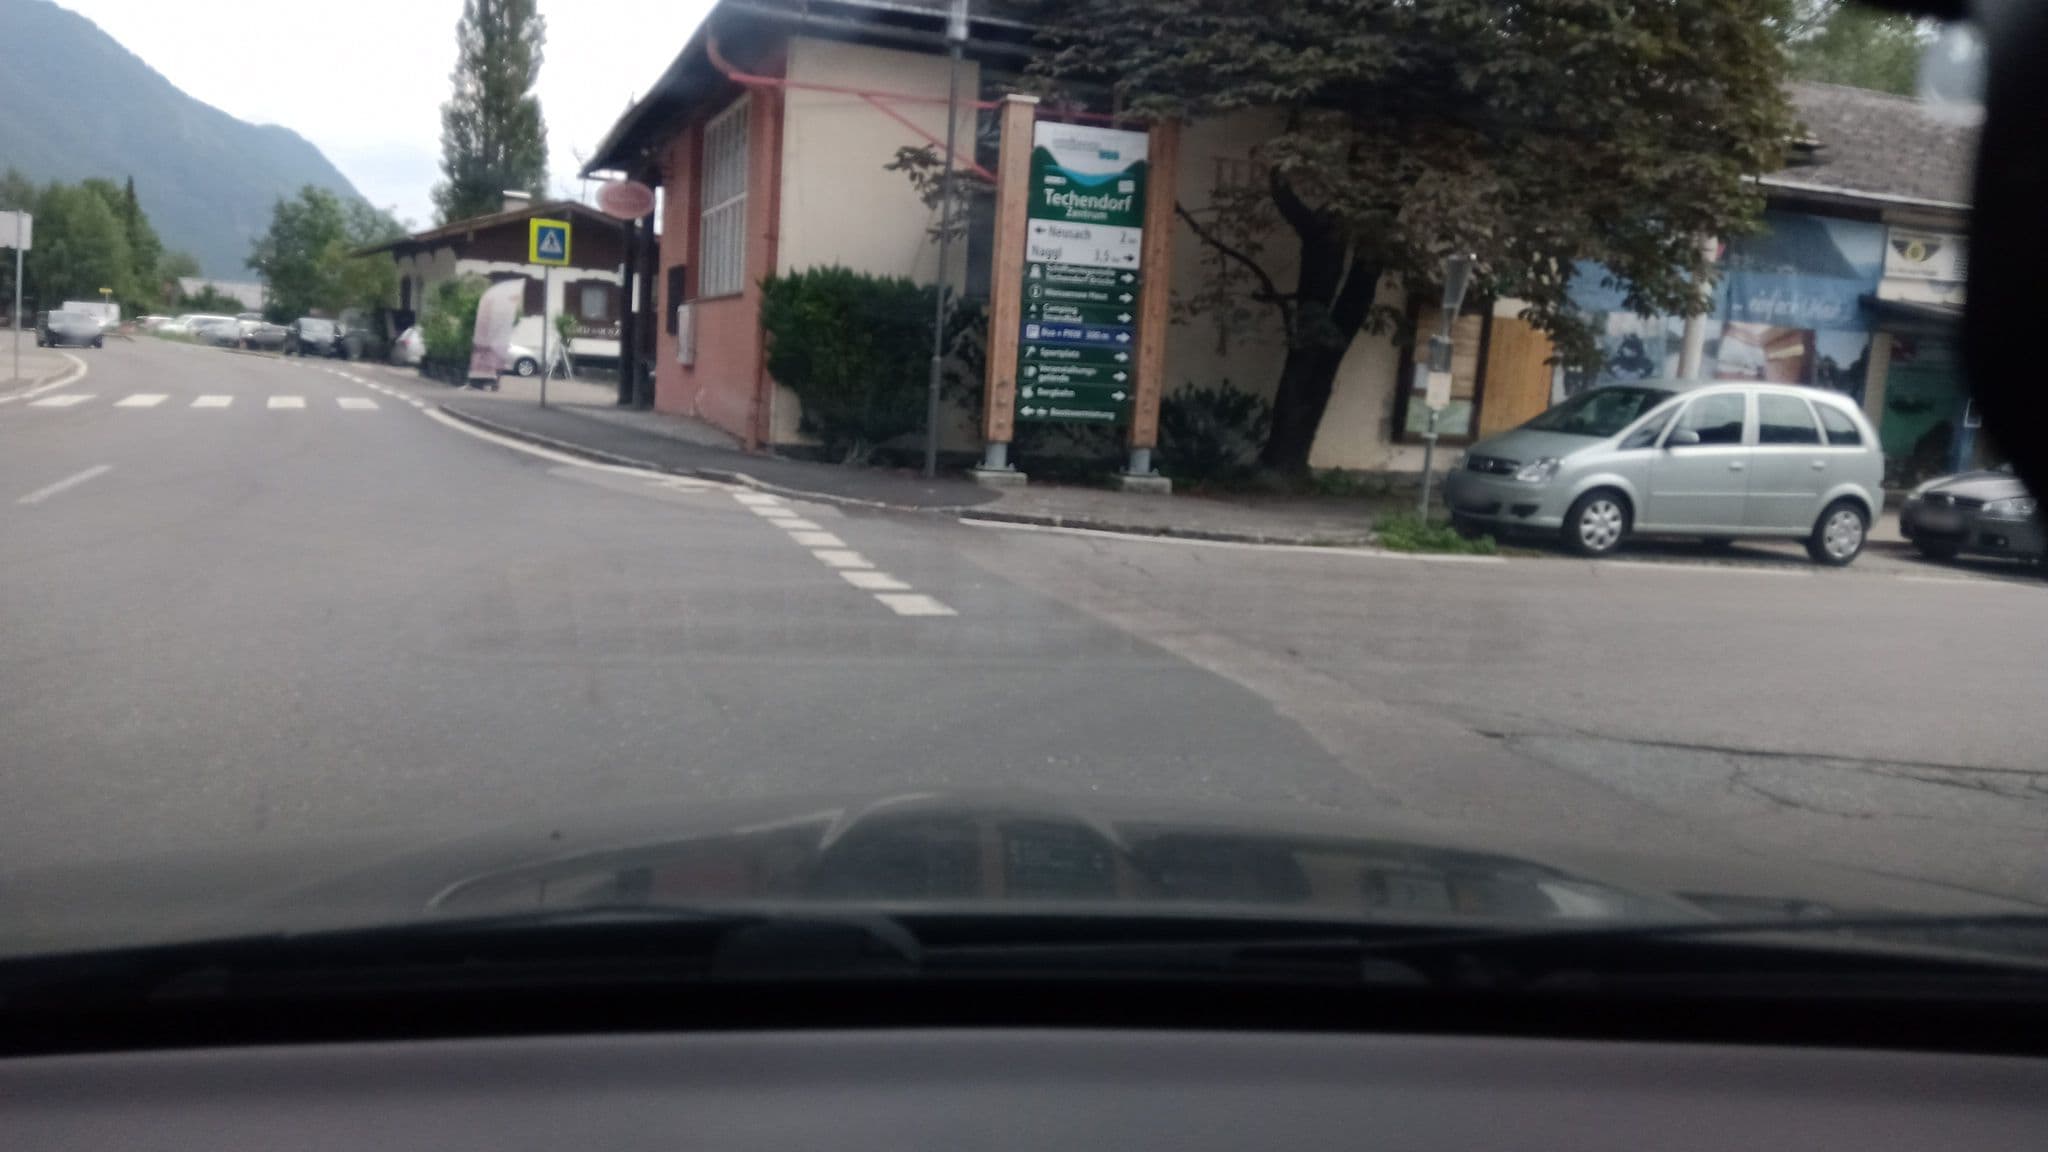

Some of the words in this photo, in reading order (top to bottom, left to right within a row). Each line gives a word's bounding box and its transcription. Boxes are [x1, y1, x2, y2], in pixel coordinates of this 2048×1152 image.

[1044, 187, 1133, 211] Techendorf
[1066, 206, 1108, 219] Zentrum
[1048, 224, 1092, 240] Neusach
[1032, 245, 1063, 261] Naggl
